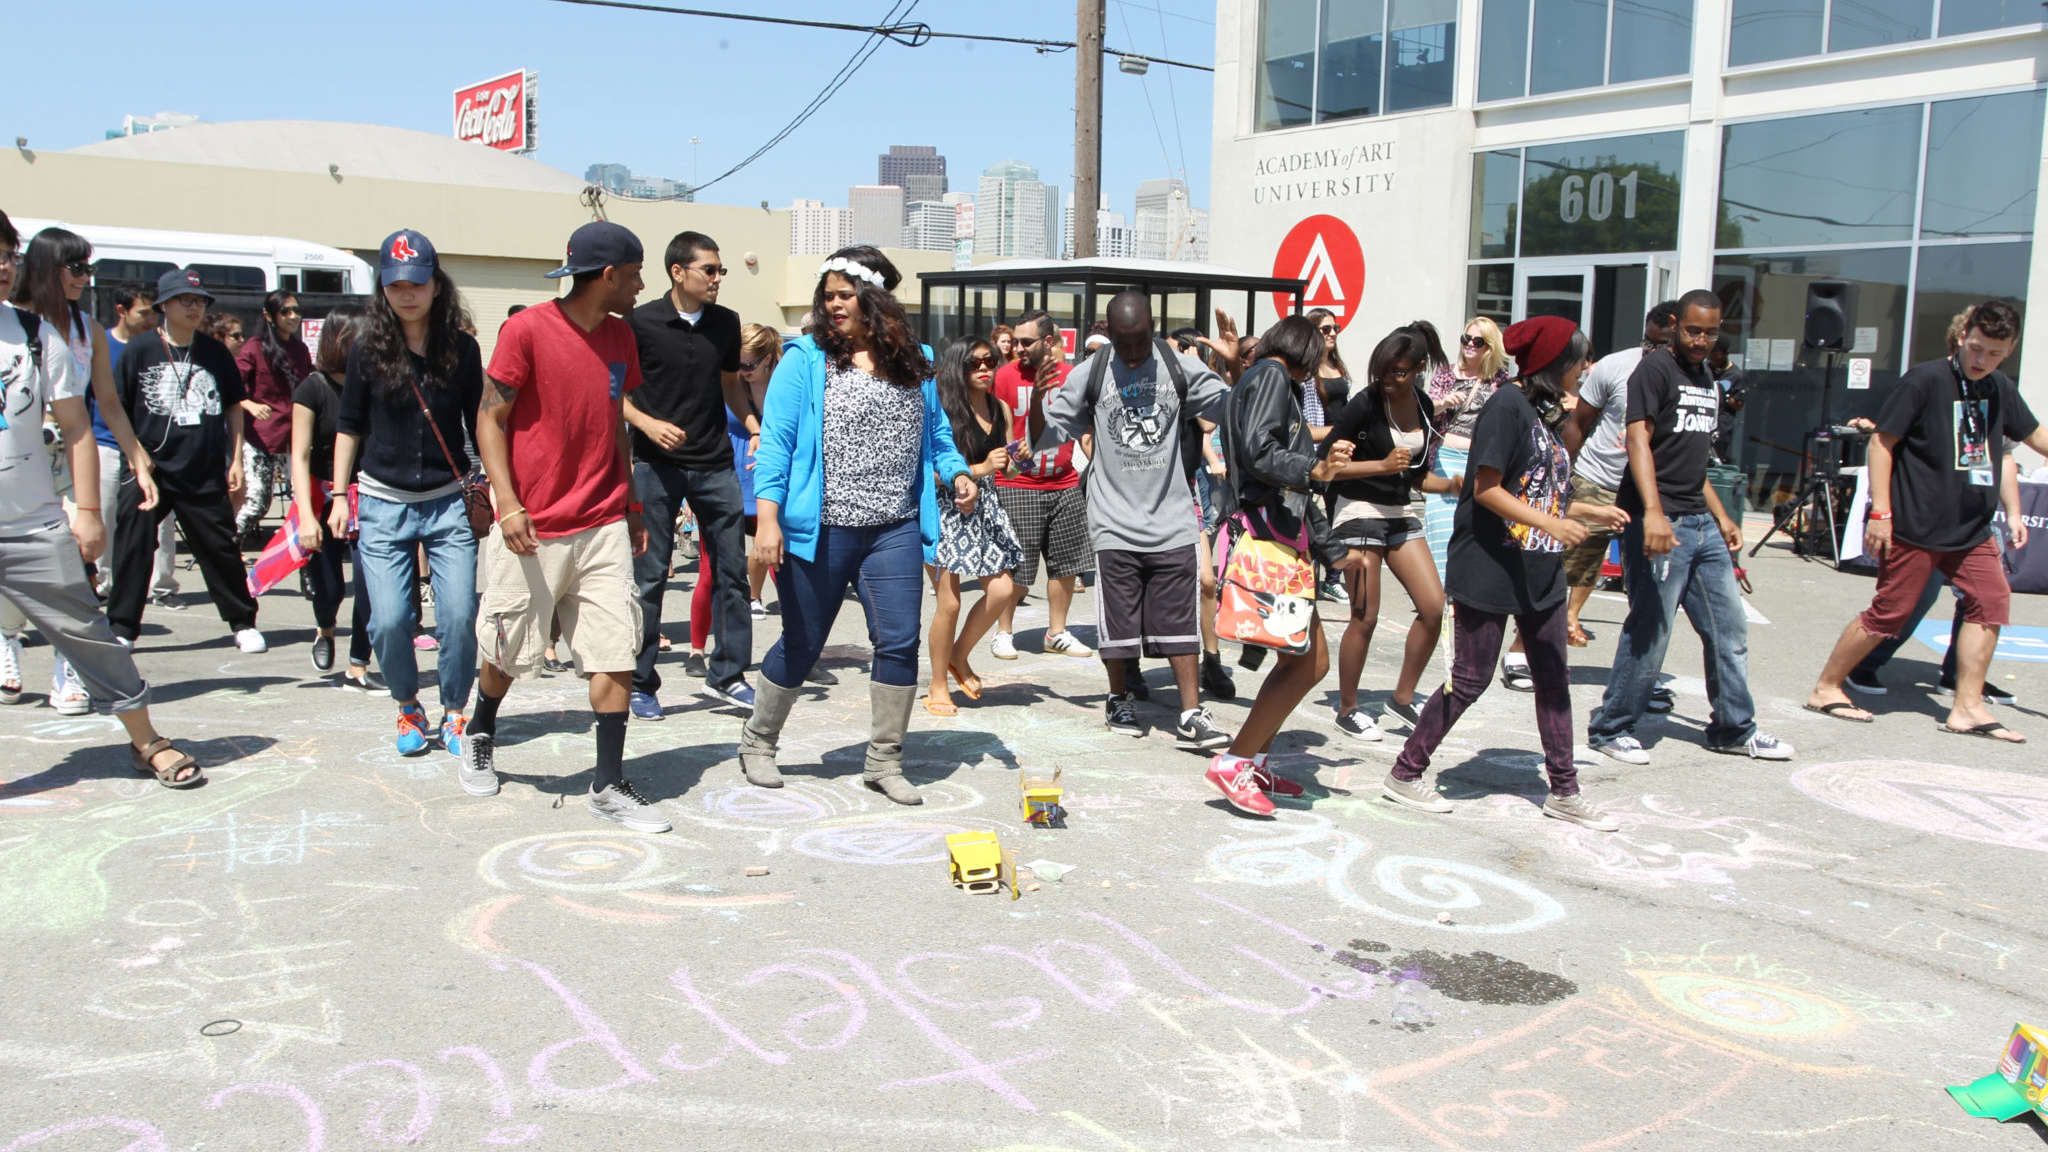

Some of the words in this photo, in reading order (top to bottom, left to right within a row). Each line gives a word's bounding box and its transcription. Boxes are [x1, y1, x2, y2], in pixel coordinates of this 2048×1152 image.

[1255, 149, 1340, 176] ACADEMY
[1341, 145, 1358, 170] of
[1358, 140, 1396, 164] ART
[1254, 172, 1395, 204] UNIVERSITY
[1560, 170, 1638, 223] 601
